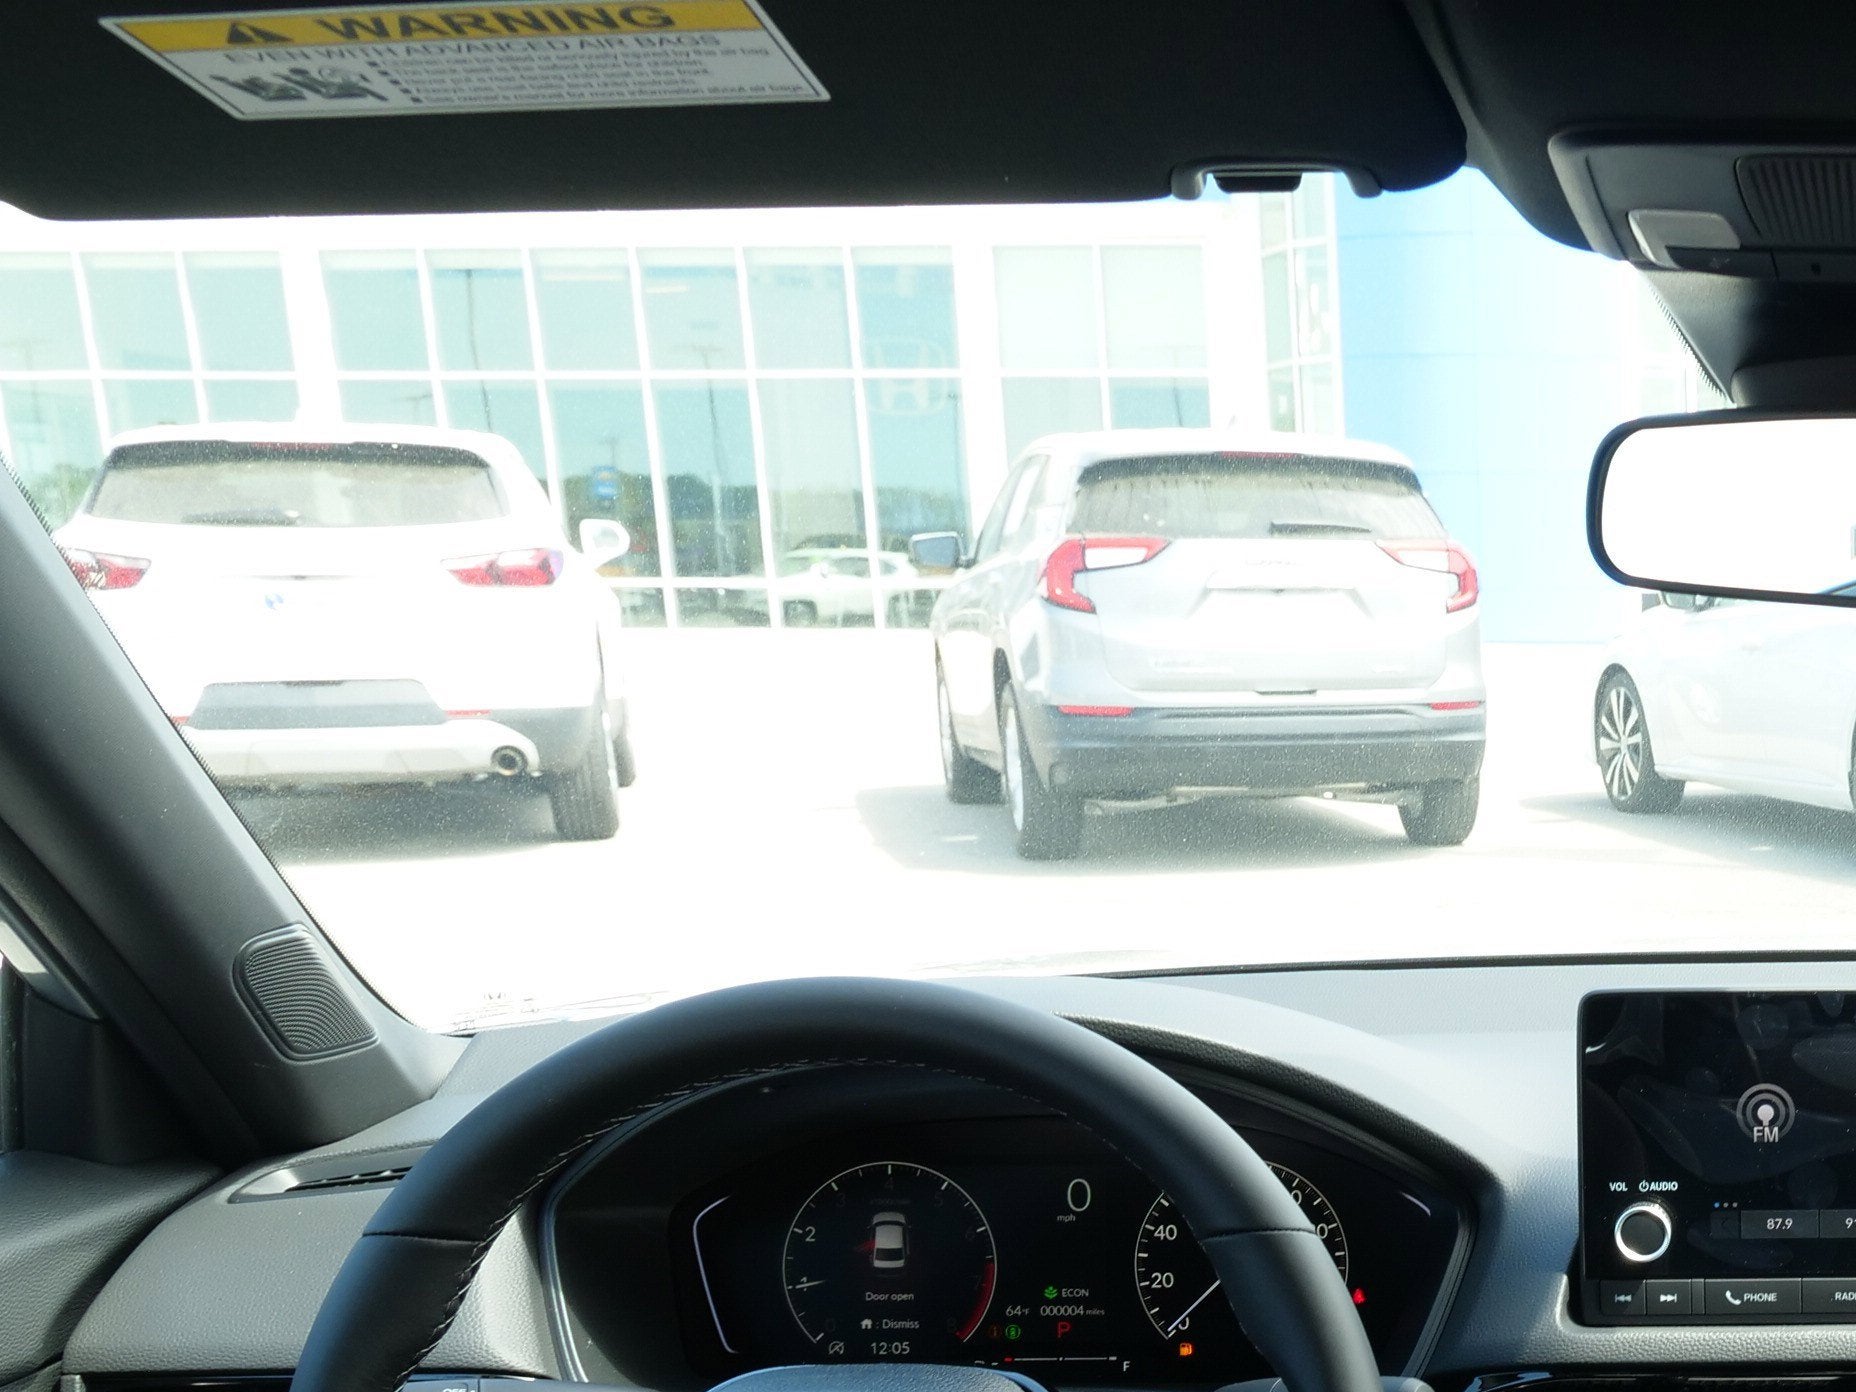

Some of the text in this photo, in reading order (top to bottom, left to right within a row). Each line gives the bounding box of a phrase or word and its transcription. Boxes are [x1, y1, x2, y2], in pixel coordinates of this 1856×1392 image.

[314, 4, 676, 40] WARNING
[403, 39, 569, 57] ADVANCED
[578, 36, 626, 50] AIR
[633, 33, 721, 48] BAGS
[1753, 1126, 1779, 1143] FM
[1609, 1181, 1679, 1192] VOL AUDIO
[1066, 1178, 1092, 1212] 0
[1056, 1213, 1077, 1223] mph
[1766, 1218, 1793, 1230] 87.9
[804, 1225, 816, 1243] 2
[1153, 1224, 1178, 1241] 40
[1150, 1272, 1175, 1289] 20
[865, 1291, 915, 1302] Door open
[1061, 1288, 1090, 1298] ECON
[1743, 1292, 1778, 1302] PHONE
[1040, 1305, 1085, 1317] 000004
[1085, 1307, 1106, 1316] miles
[882, 1319, 920, 1330] Dismiss
[1057, 1322, 1072, 1338] P
[870, 1341, 911, 1355] 12:05
[1123, 1360, 1131, 1372] F
